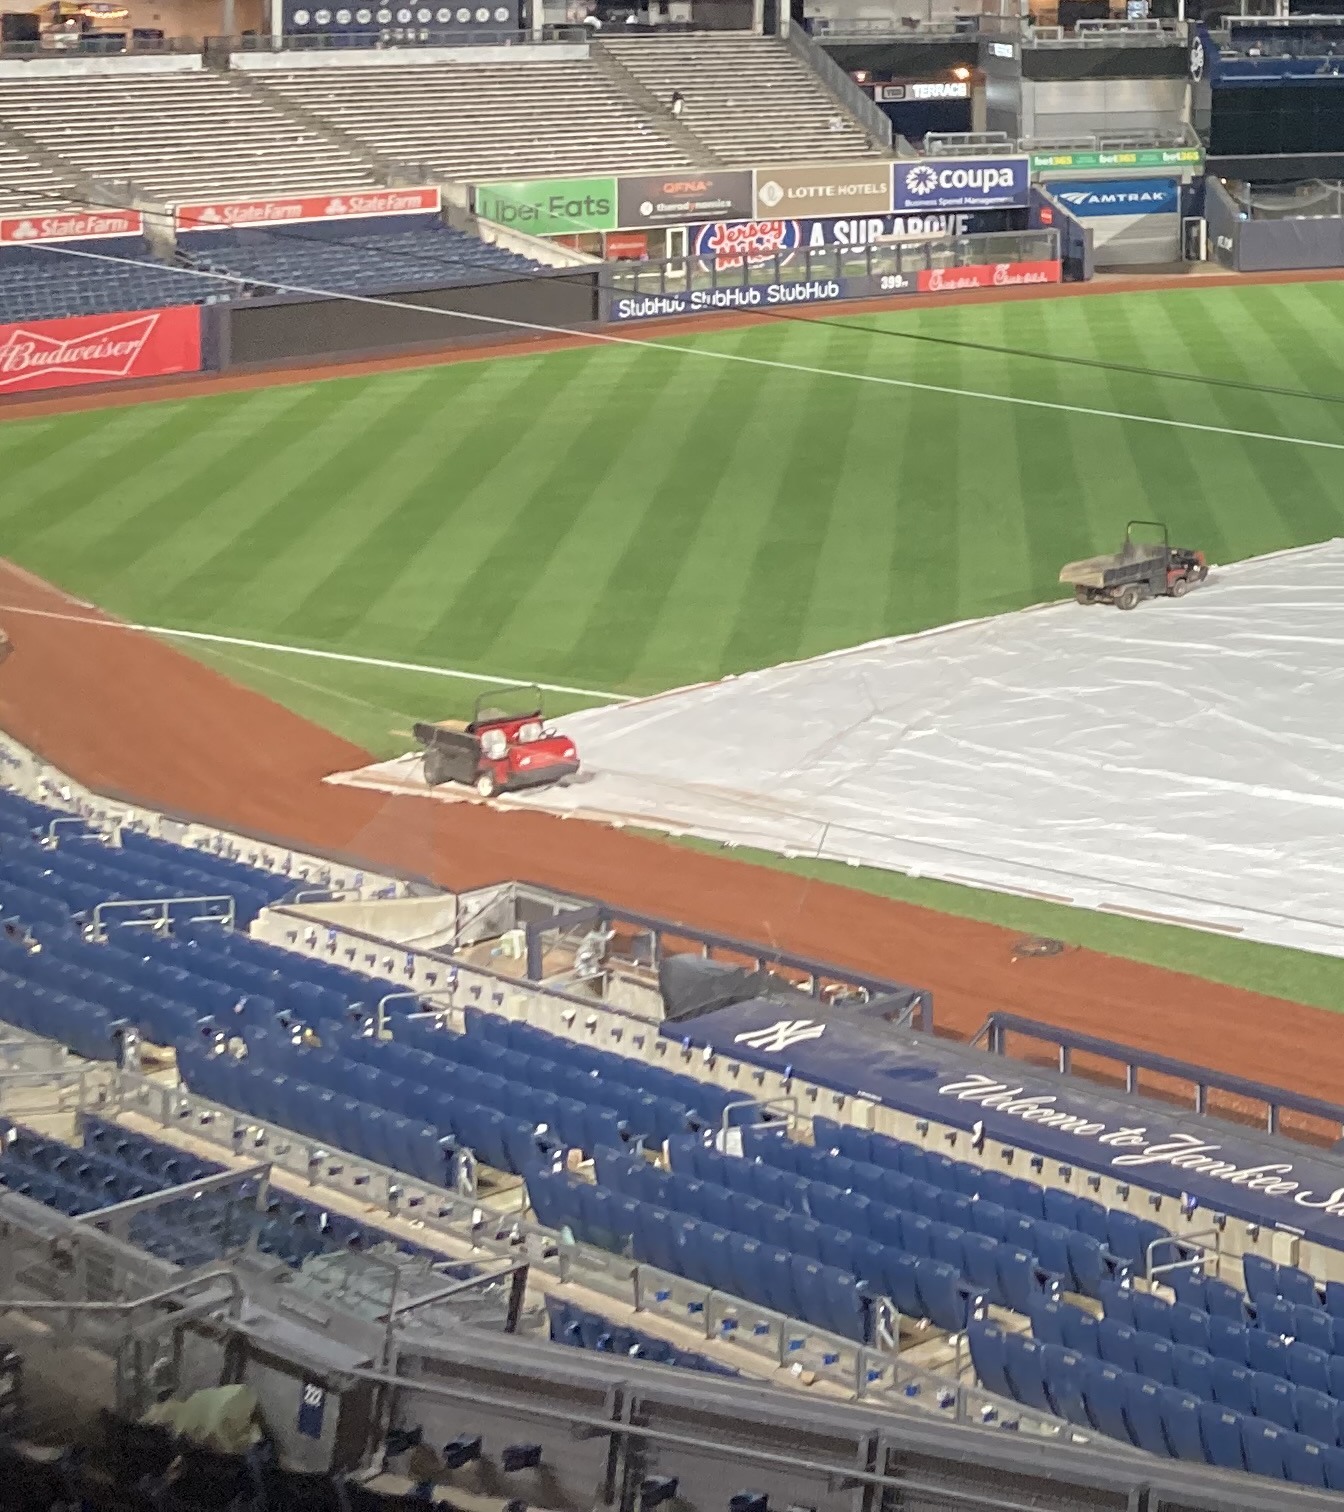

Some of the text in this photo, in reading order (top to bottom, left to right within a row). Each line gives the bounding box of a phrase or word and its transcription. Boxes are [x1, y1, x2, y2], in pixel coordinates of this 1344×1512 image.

[912, 83, 967, 99] TERRACE
[788, 182, 888, 198] LOTTE HOTELS
[940, 167, 1014, 194] coupa
[549, 195, 611, 218] Eats
[1088, 191, 1163, 204] AMTRAK
[711, 220, 783, 246] Jersey
[809, 224, 827, 256] A
[767, 280, 839, 303] StubHub
[881, 274, 902, 289] 399
[691, 284, 760, 309] StubHub
[3, 337, 142, 373] Budweiser
[939, 1074, 1106, 1136] Welcome
[1100, 1127, 1147, 1147] to
[1111, 1133, 1298, 1198] Yankee
